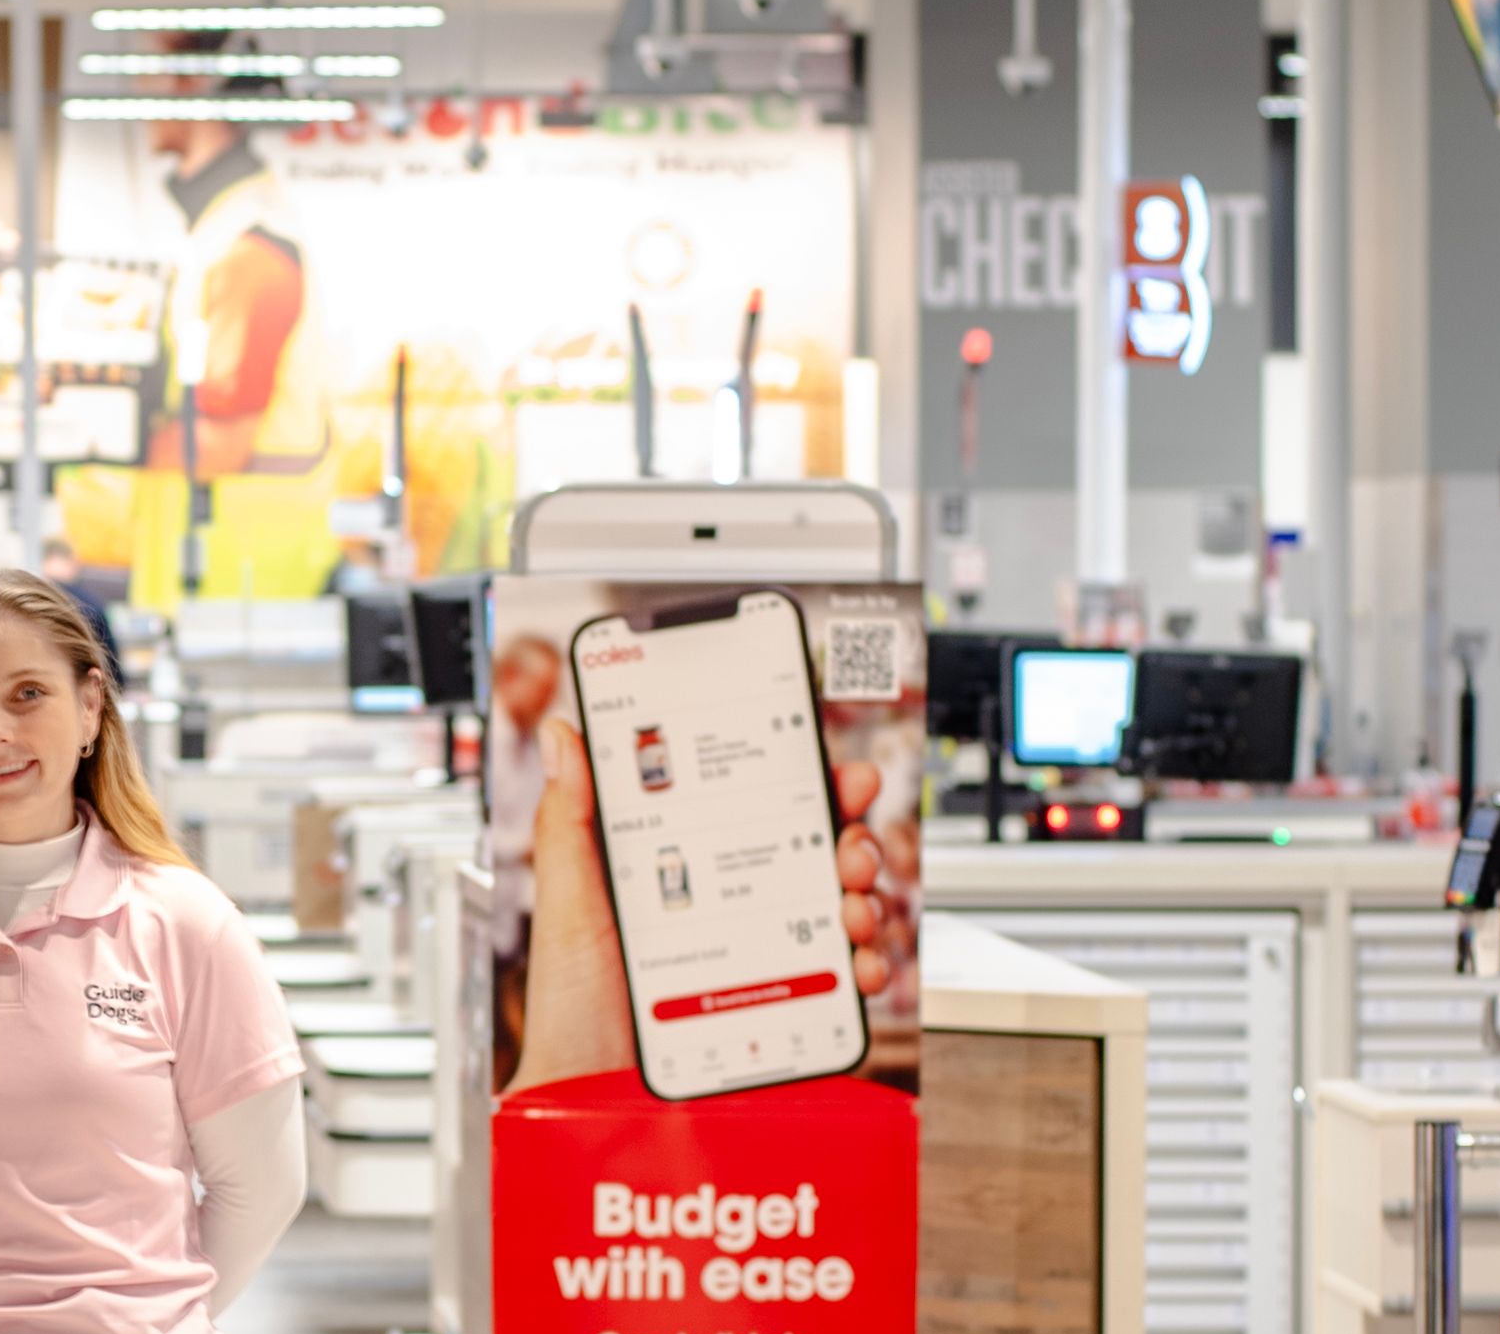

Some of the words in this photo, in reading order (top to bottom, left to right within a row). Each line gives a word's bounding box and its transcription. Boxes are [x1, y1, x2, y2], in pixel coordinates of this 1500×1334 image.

[583, 644, 645, 668] coles
[84, 982, 146, 1004] Guide
[87, 1002, 145, 1025] Dogs
[593, 1183, 818, 1252] Budget
[554, 1246, 685, 1300] with
[700, 1257, 854, 1301] ease
